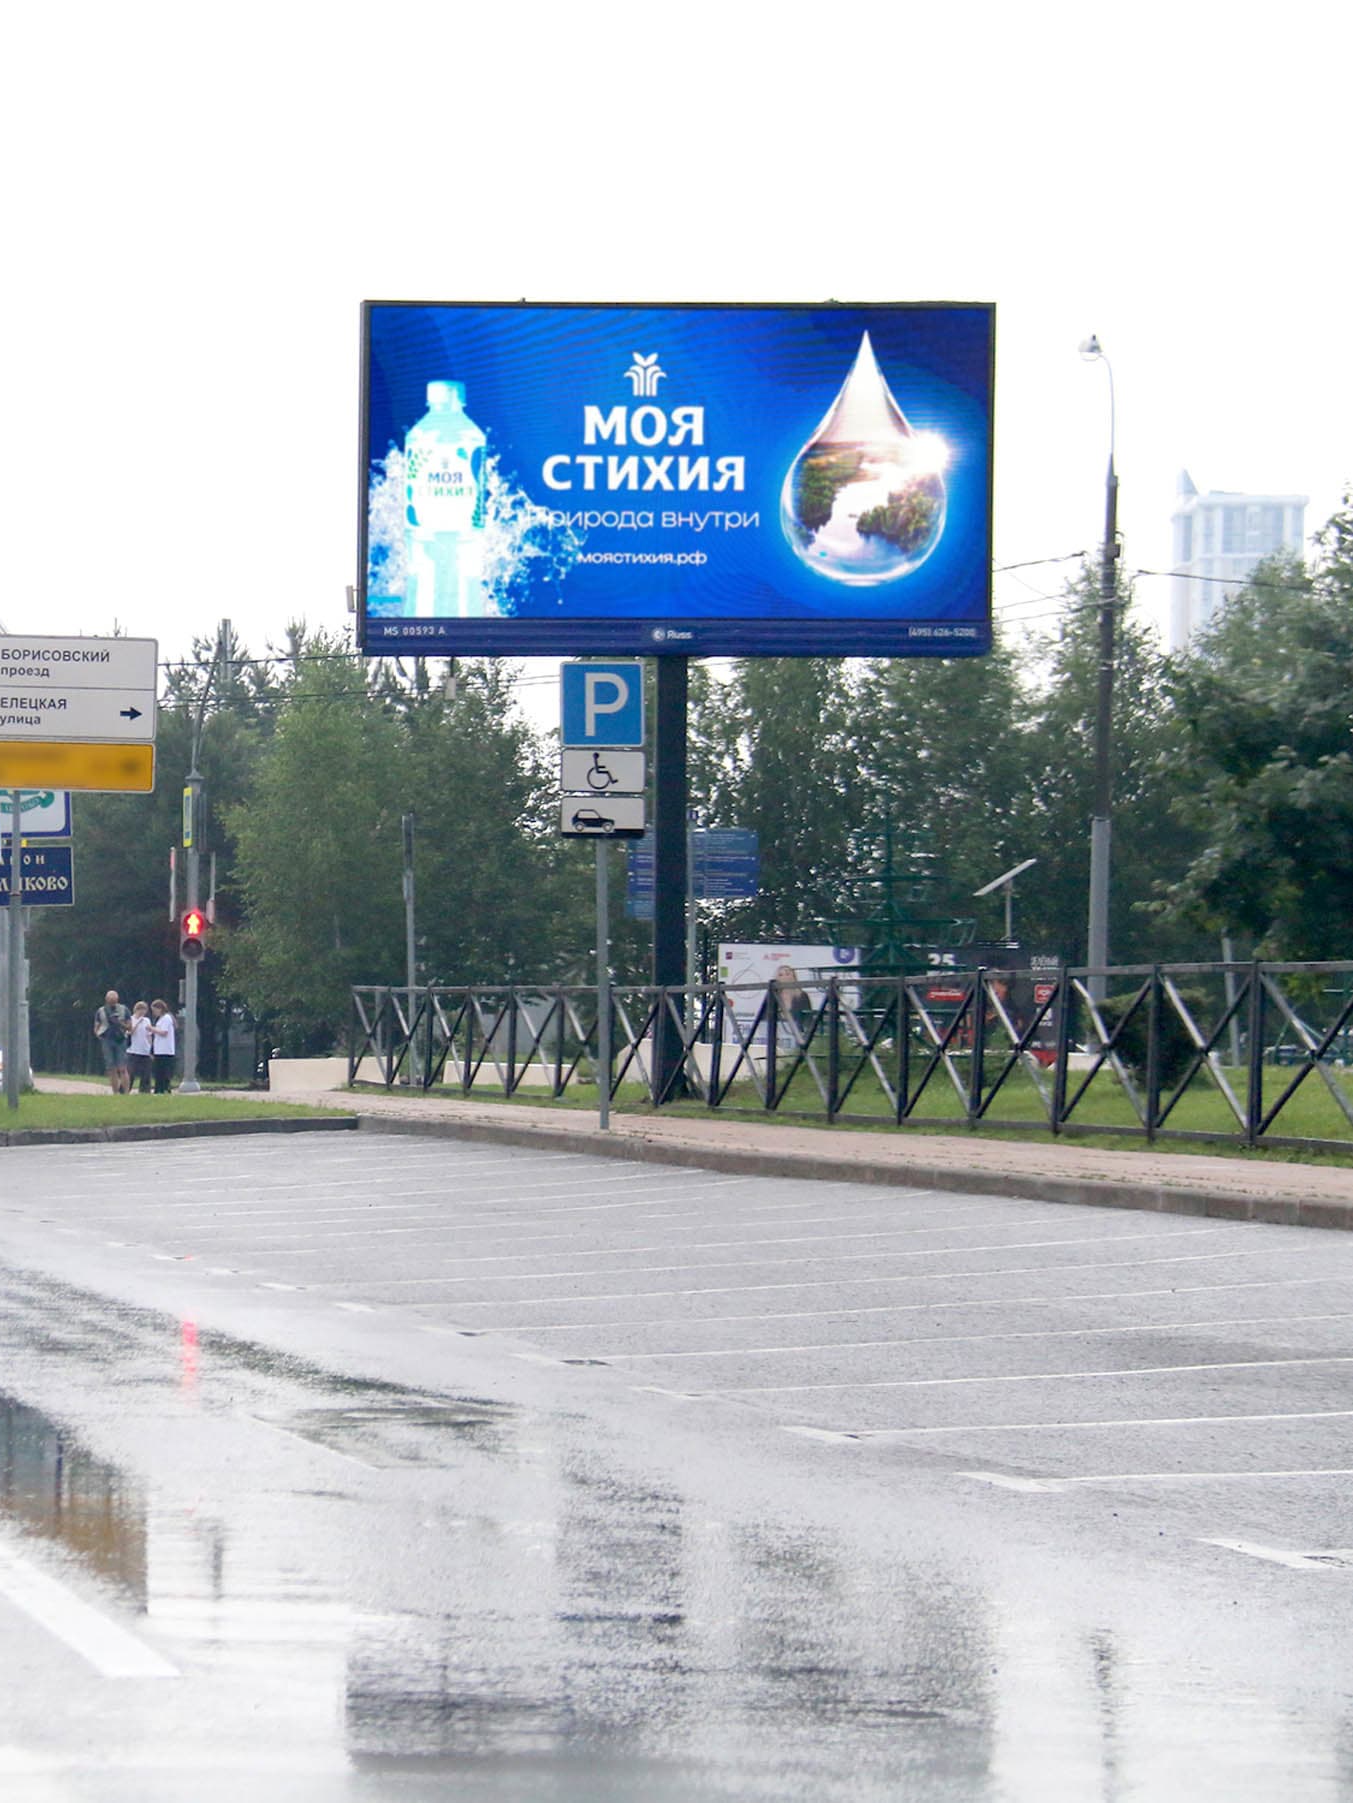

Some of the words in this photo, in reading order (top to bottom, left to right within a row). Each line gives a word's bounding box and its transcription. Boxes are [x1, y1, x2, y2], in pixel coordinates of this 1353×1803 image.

[584, 405, 704, 446] МОЯ
[542, 455, 745, 491] СТИХИЯ
[661, 511, 760, 532] внутри
[577, 550, 708, 566] моястихия.рф
[383, 626, 399, 636] MS
[0, 648, 110, 663] БОРИСОВСКИЙ
[0, 666, 50, 677] проезд
[0, 697, 67, 711] ЕЛЕЦКАЯ
[0, 715, 41, 726] улица
